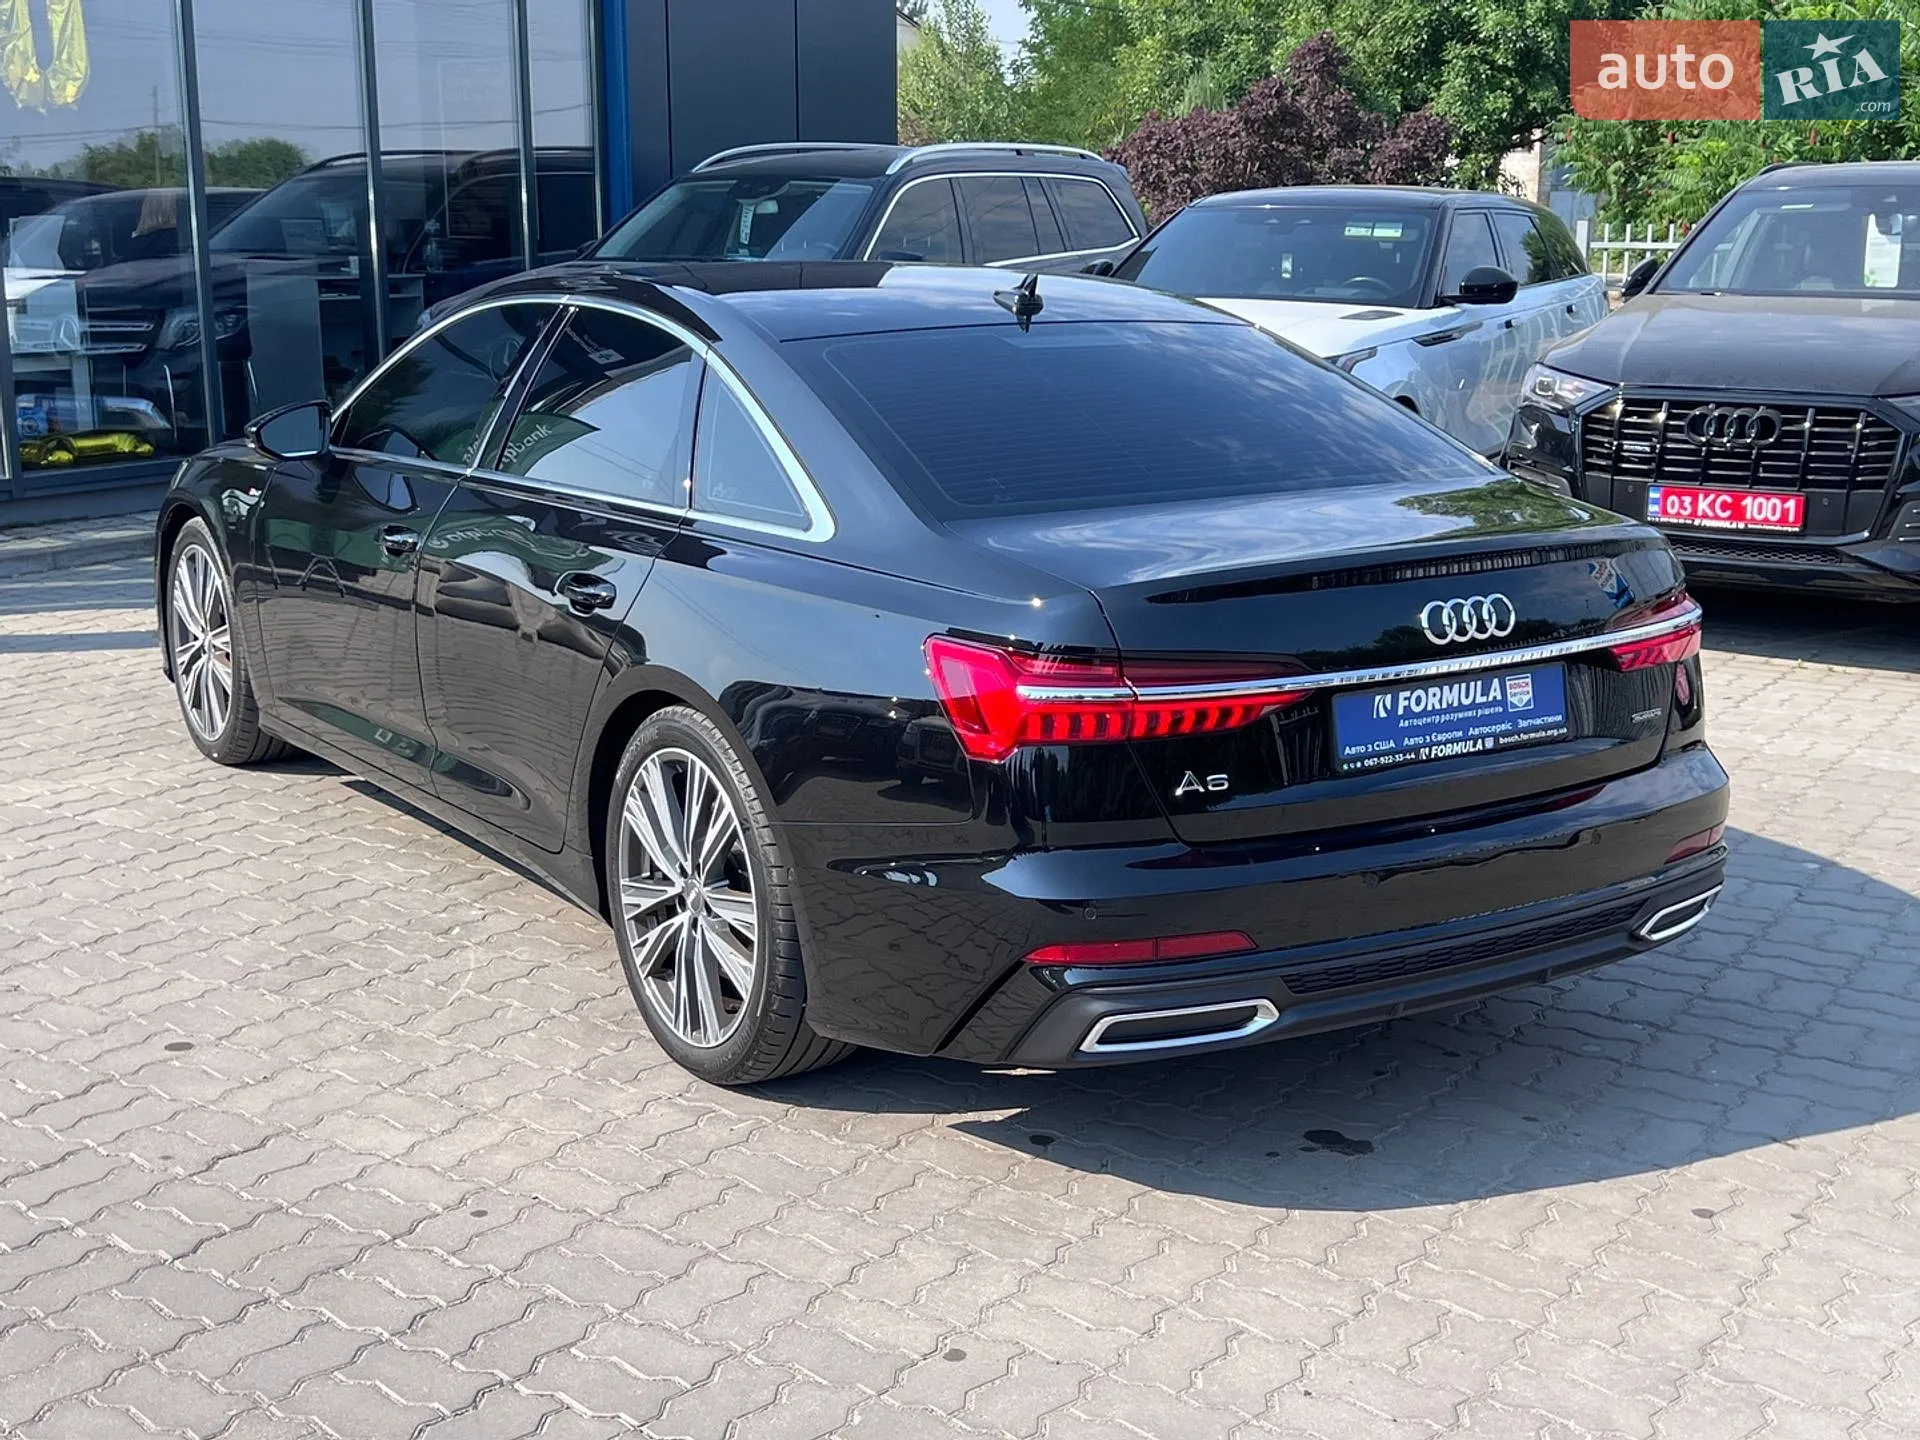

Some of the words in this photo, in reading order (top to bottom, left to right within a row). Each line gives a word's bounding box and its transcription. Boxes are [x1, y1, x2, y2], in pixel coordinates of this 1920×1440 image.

[1666, 495, 1692, 516] 03
[1741, 496, 1796, 523] 1001
[1397, 678, 1502, 716] FORMULA
[1398, 715, 1440, 728] Автоцентр
[1468, 721, 1513, 736] Автосервіс
[1517, 714, 1562, 728] Запчастини
[1344, 745, 1366, 755] Авто
[1374, 739, 1396, 751] США
[1403, 736, 1423, 747] Авто
[1431, 730, 1463, 745] Європи
[1430, 738, 1483, 758] FORMULA
[1175, 771, 1229, 796] A6
